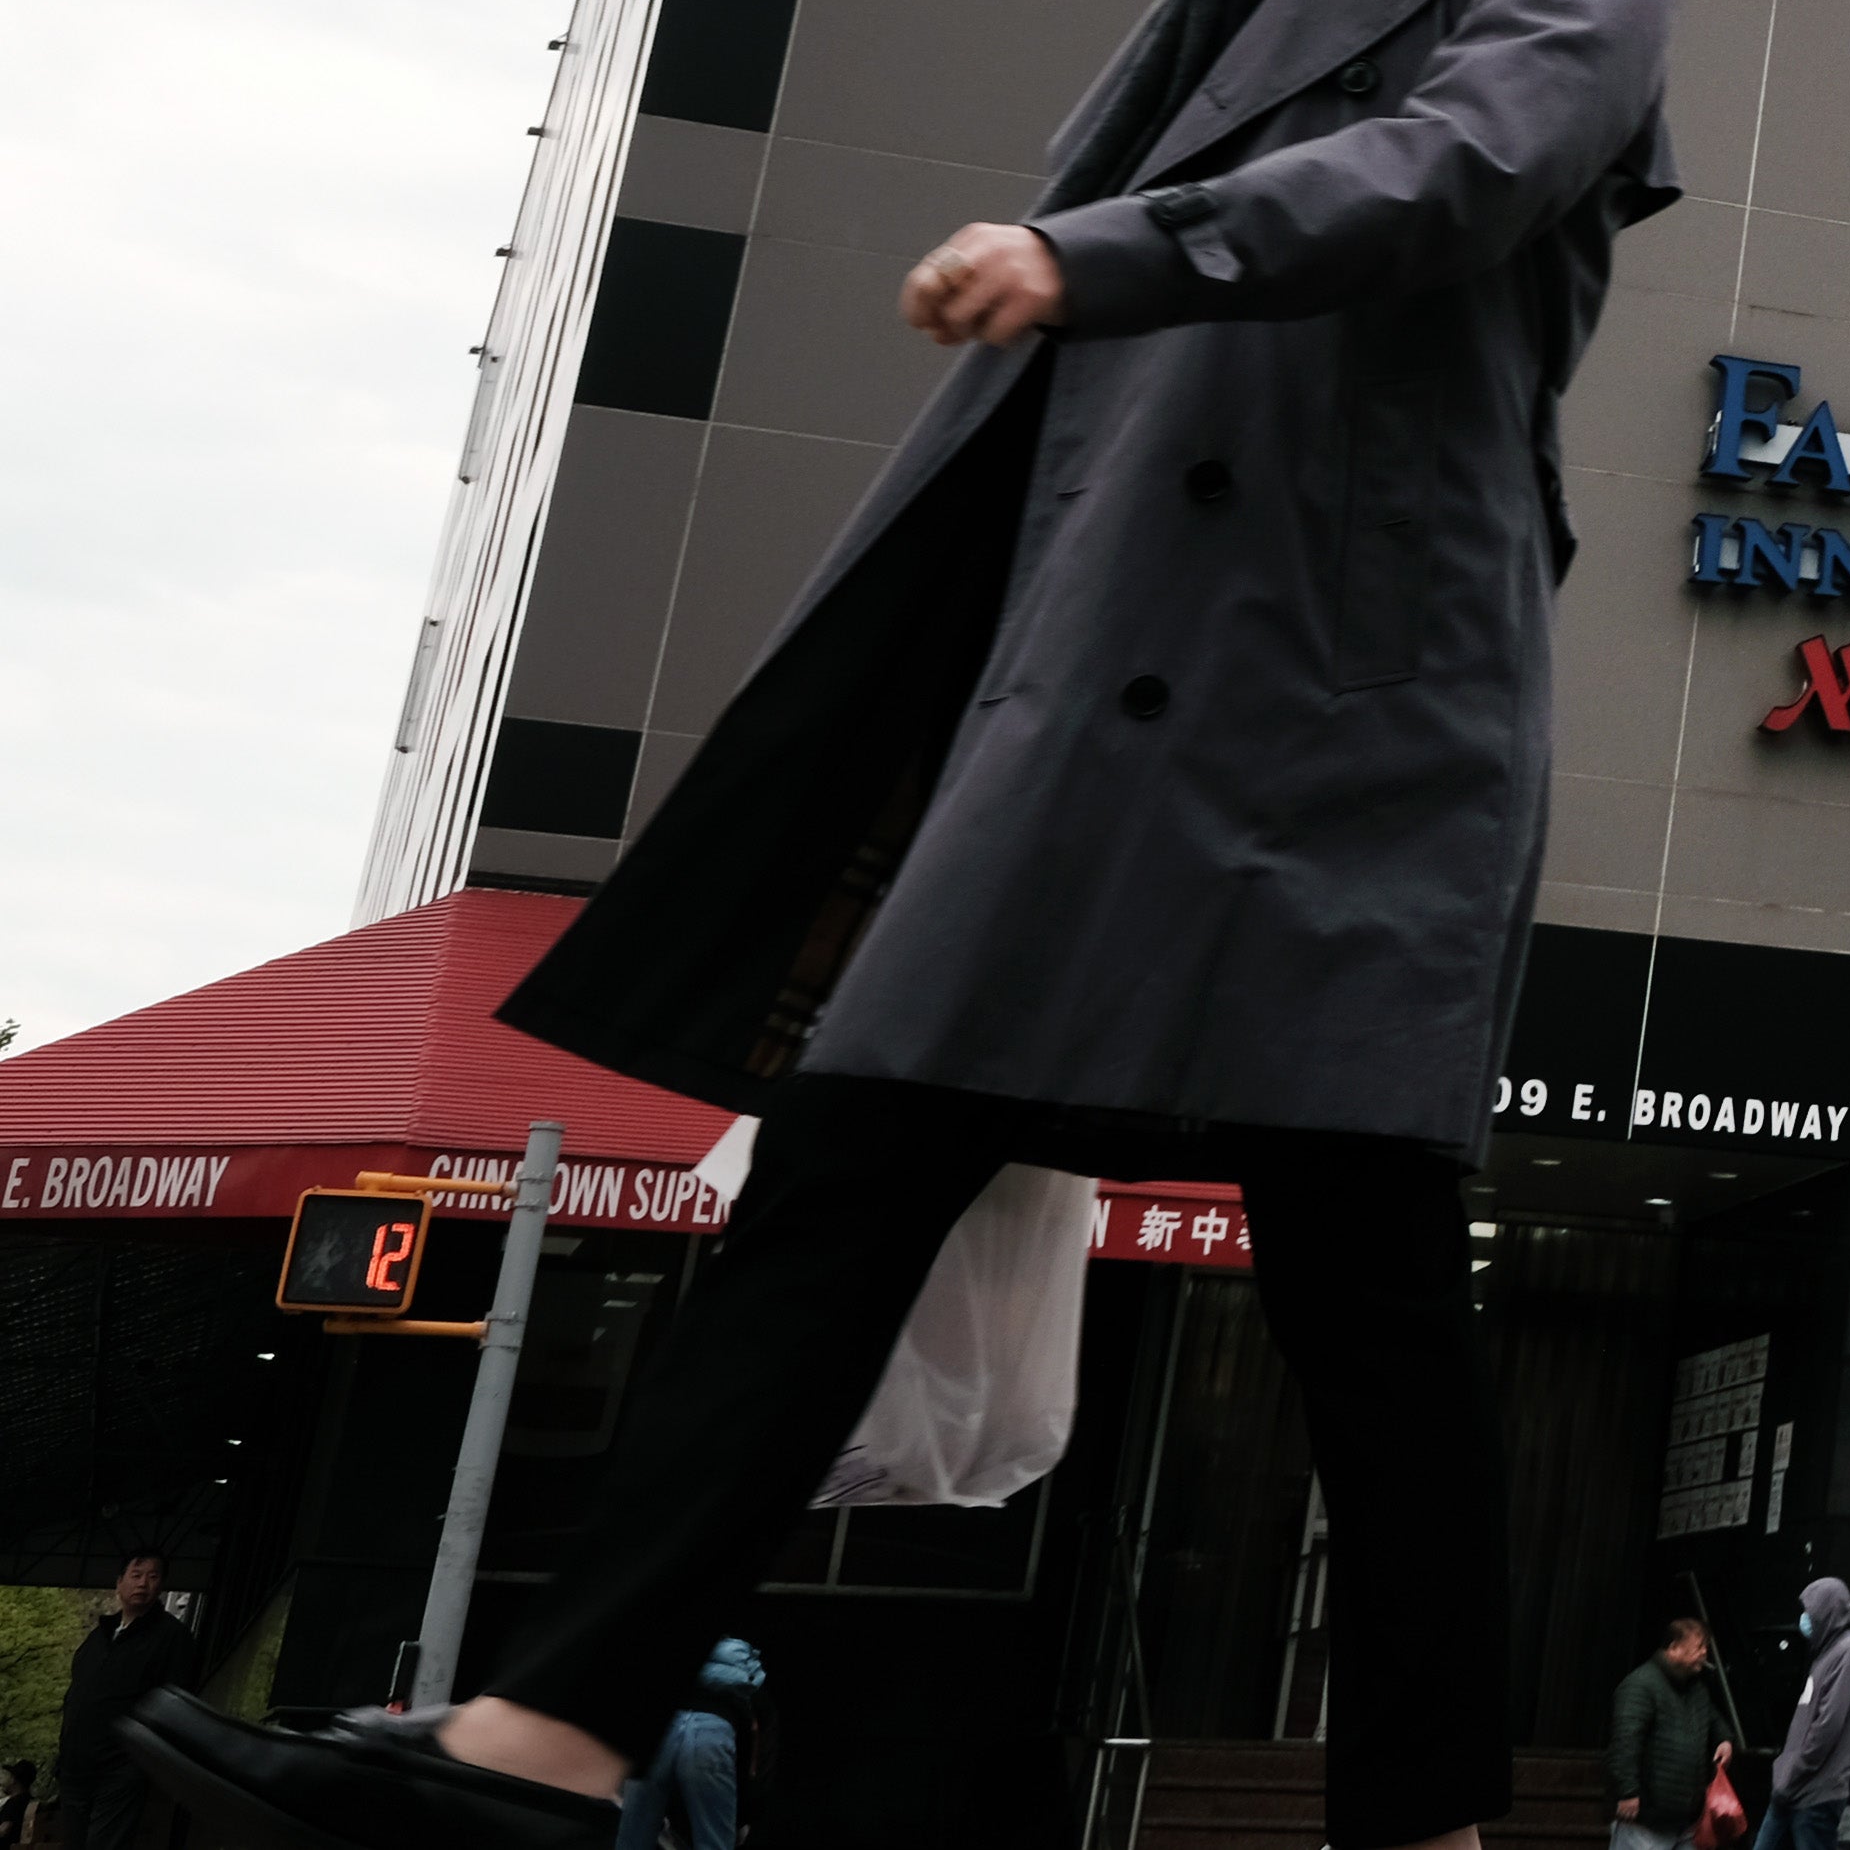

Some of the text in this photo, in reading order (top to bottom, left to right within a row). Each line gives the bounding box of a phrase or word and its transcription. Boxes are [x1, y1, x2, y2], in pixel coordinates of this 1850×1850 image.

[1571, 1083, 1607, 1122] E.
[1632, 1089, 1849, 1142] BROADWAY
[42, 1155, 231, 1209] BROADWAY
[425, 1154, 626, 1219] CHINOWN
[365, 1222, 415, 1292] 12
